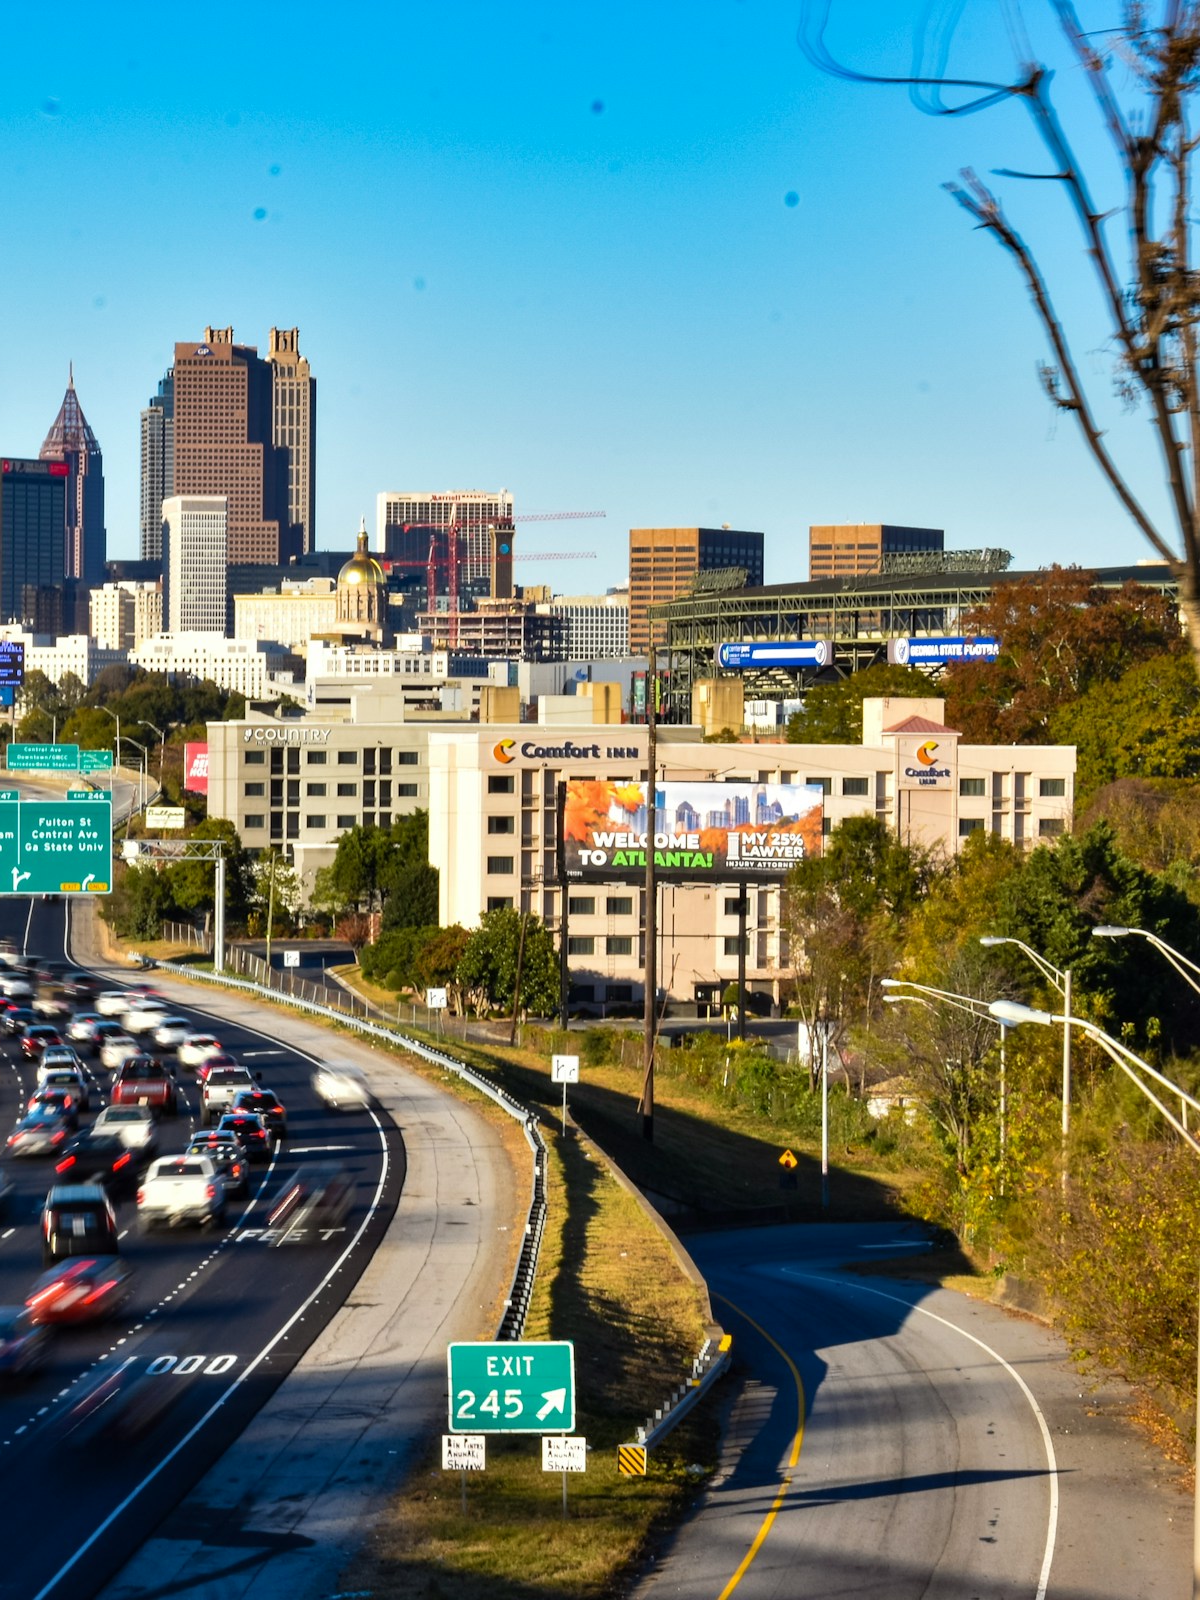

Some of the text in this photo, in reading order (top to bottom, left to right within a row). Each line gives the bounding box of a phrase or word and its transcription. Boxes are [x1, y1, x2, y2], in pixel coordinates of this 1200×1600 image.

[910, 645, 939, 656] GEORGIA
[940, 645, 962, 655] STATE
[254, 729, 331, 741] COUNTRY
[521, 742, 639, 758] Comfort INN
[905, 767, 951, 777] Comfort
[88, 792, 104, 800] 246
[39, 818, 91, 827] Fulton St
[32, 830, 98, 839] Central Ave
[592, 832, 700, 849] WELCOME
[742, 832, 804, 846] MY 25%
[25, 843, 104, 852] Ga State Univ
[742, 846, 803, 858] LAWYER
[578, 850, 713, 868] TO ATLANTA!
[235, 1227, 346, 1242] FEET
[486, 1356, 534, 1376] EXIT
[456, 1389, 524, 1419] 245
